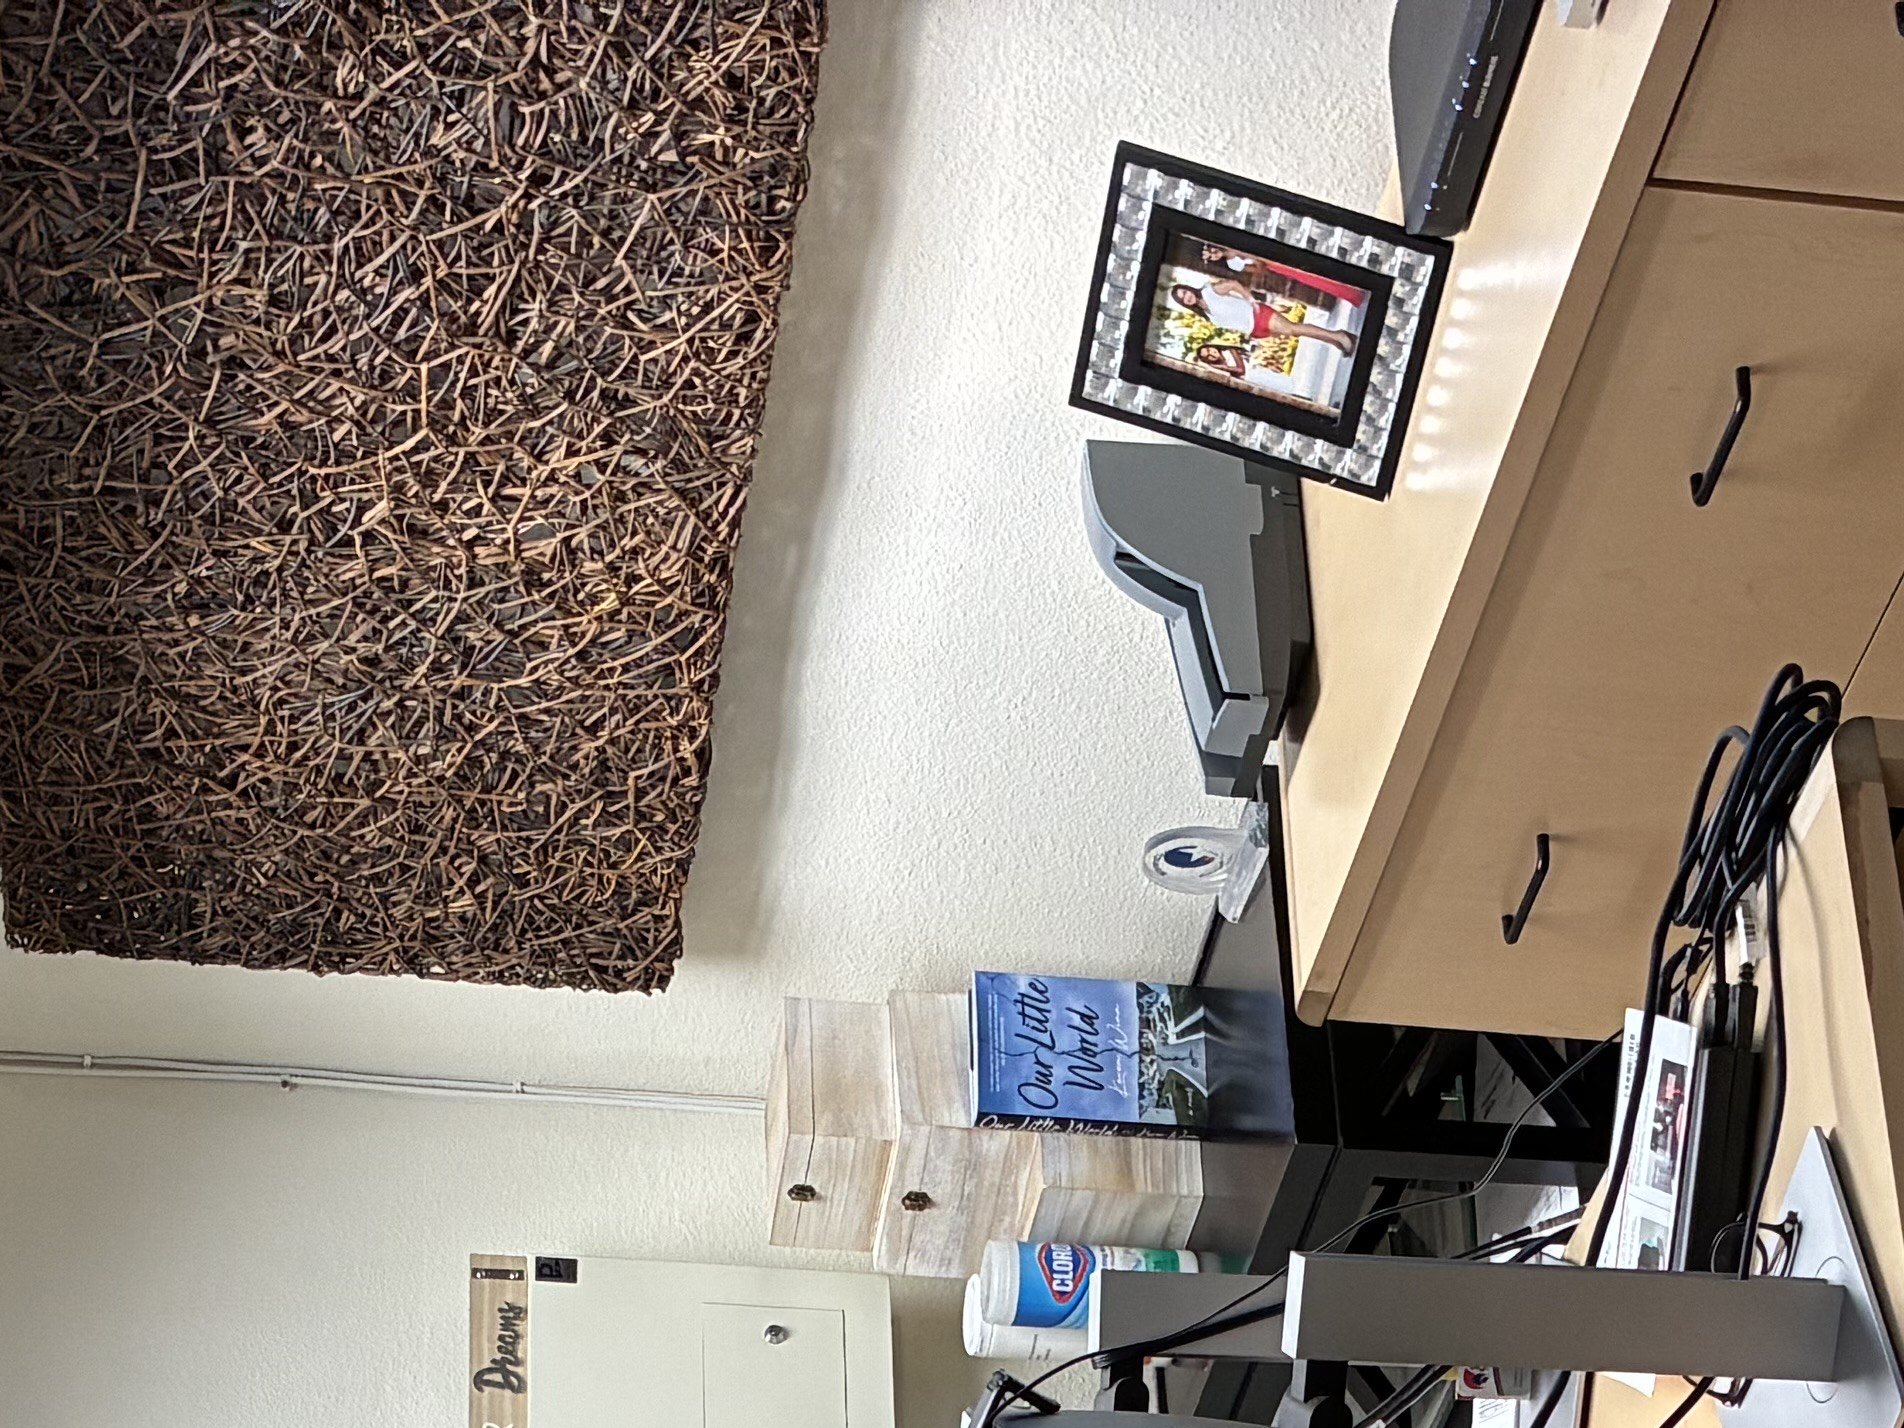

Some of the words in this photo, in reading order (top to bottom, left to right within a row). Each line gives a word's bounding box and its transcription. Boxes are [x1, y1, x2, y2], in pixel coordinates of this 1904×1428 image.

[1013, 979, 1056, 1051] Little
[1062, 1005, 1105, 1091] World
[1017, 1053, 1059, 1110] Our
[473, 1301, 524, 1395] Dreams
